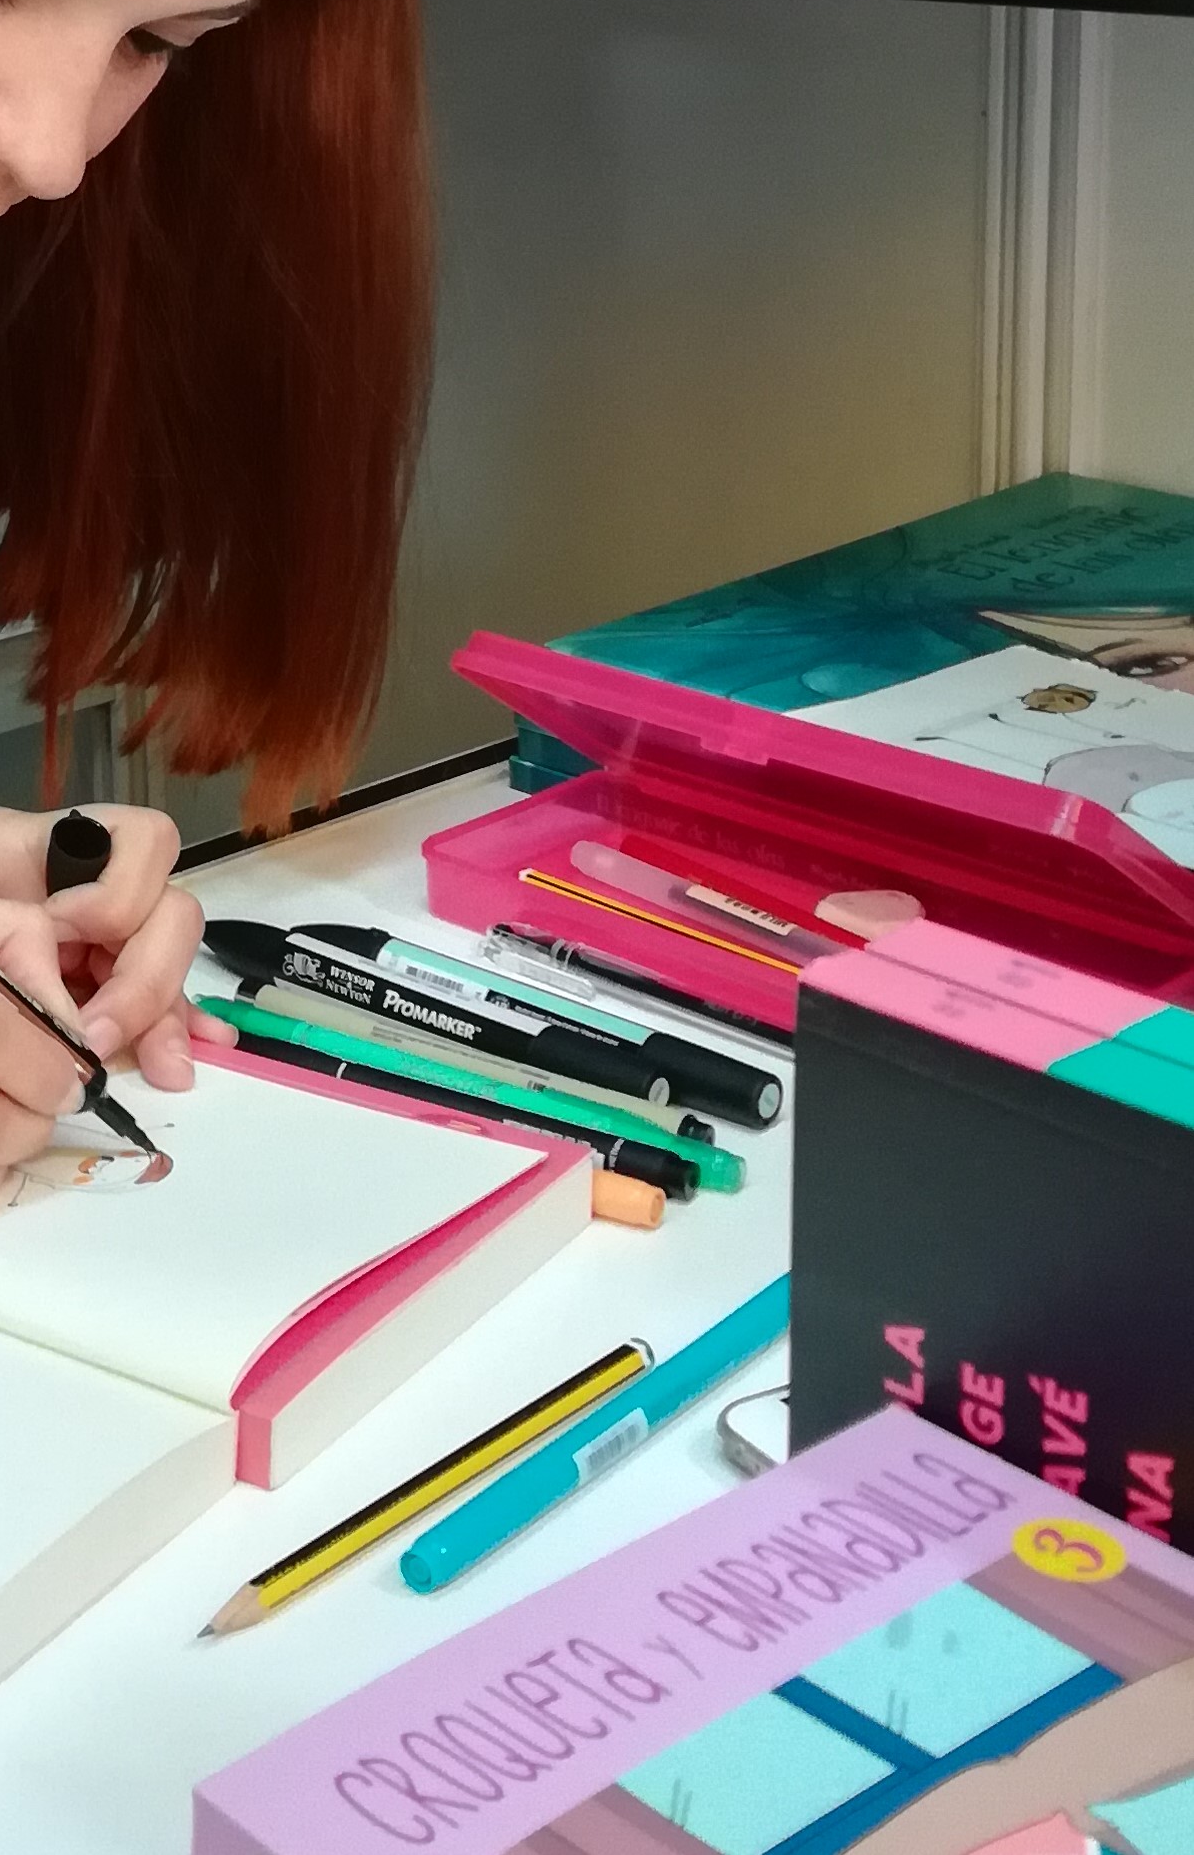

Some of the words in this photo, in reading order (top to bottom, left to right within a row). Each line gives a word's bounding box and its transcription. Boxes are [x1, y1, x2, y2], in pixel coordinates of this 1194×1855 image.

[324, 977, 372, 1006] NEWTON
[329, 964, 376, 993] WINSOR
[1034, 1528, 1105, 1574] 3
